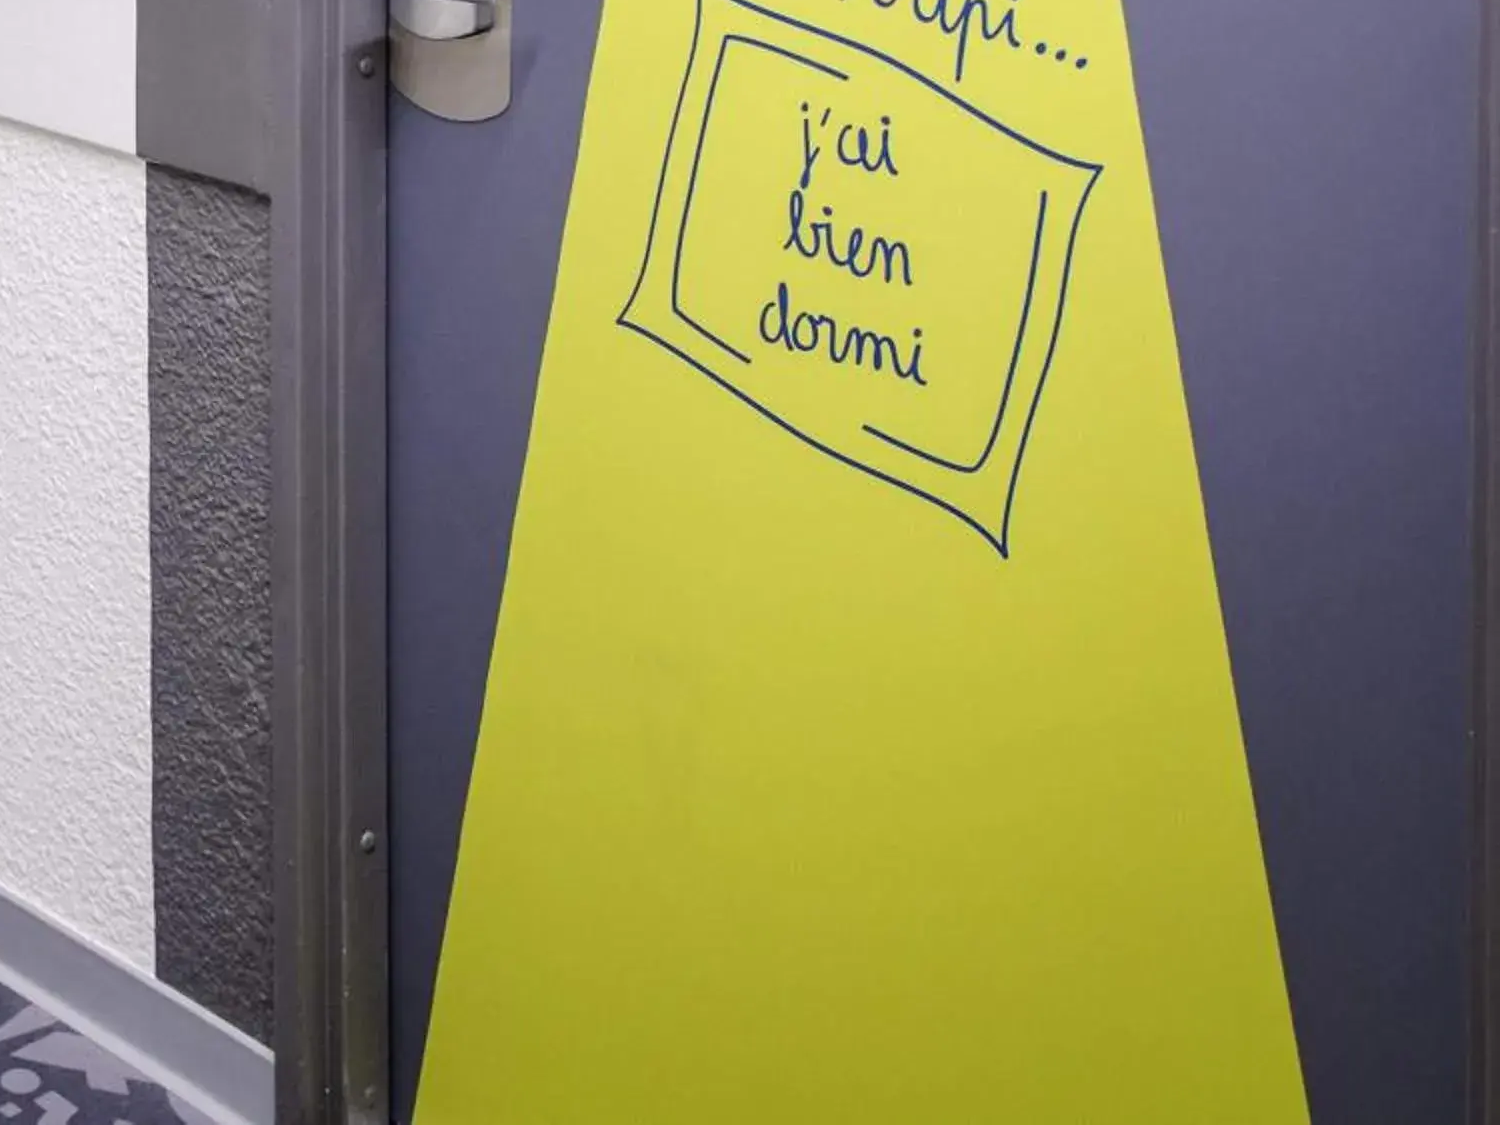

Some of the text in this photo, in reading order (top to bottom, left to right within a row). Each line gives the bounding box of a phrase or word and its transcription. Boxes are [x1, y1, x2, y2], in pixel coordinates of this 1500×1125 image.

[800, 102, 899, 191] j'ai
[783, 190, 913, 287] bien
[760, 282, 928, 387] dormi
